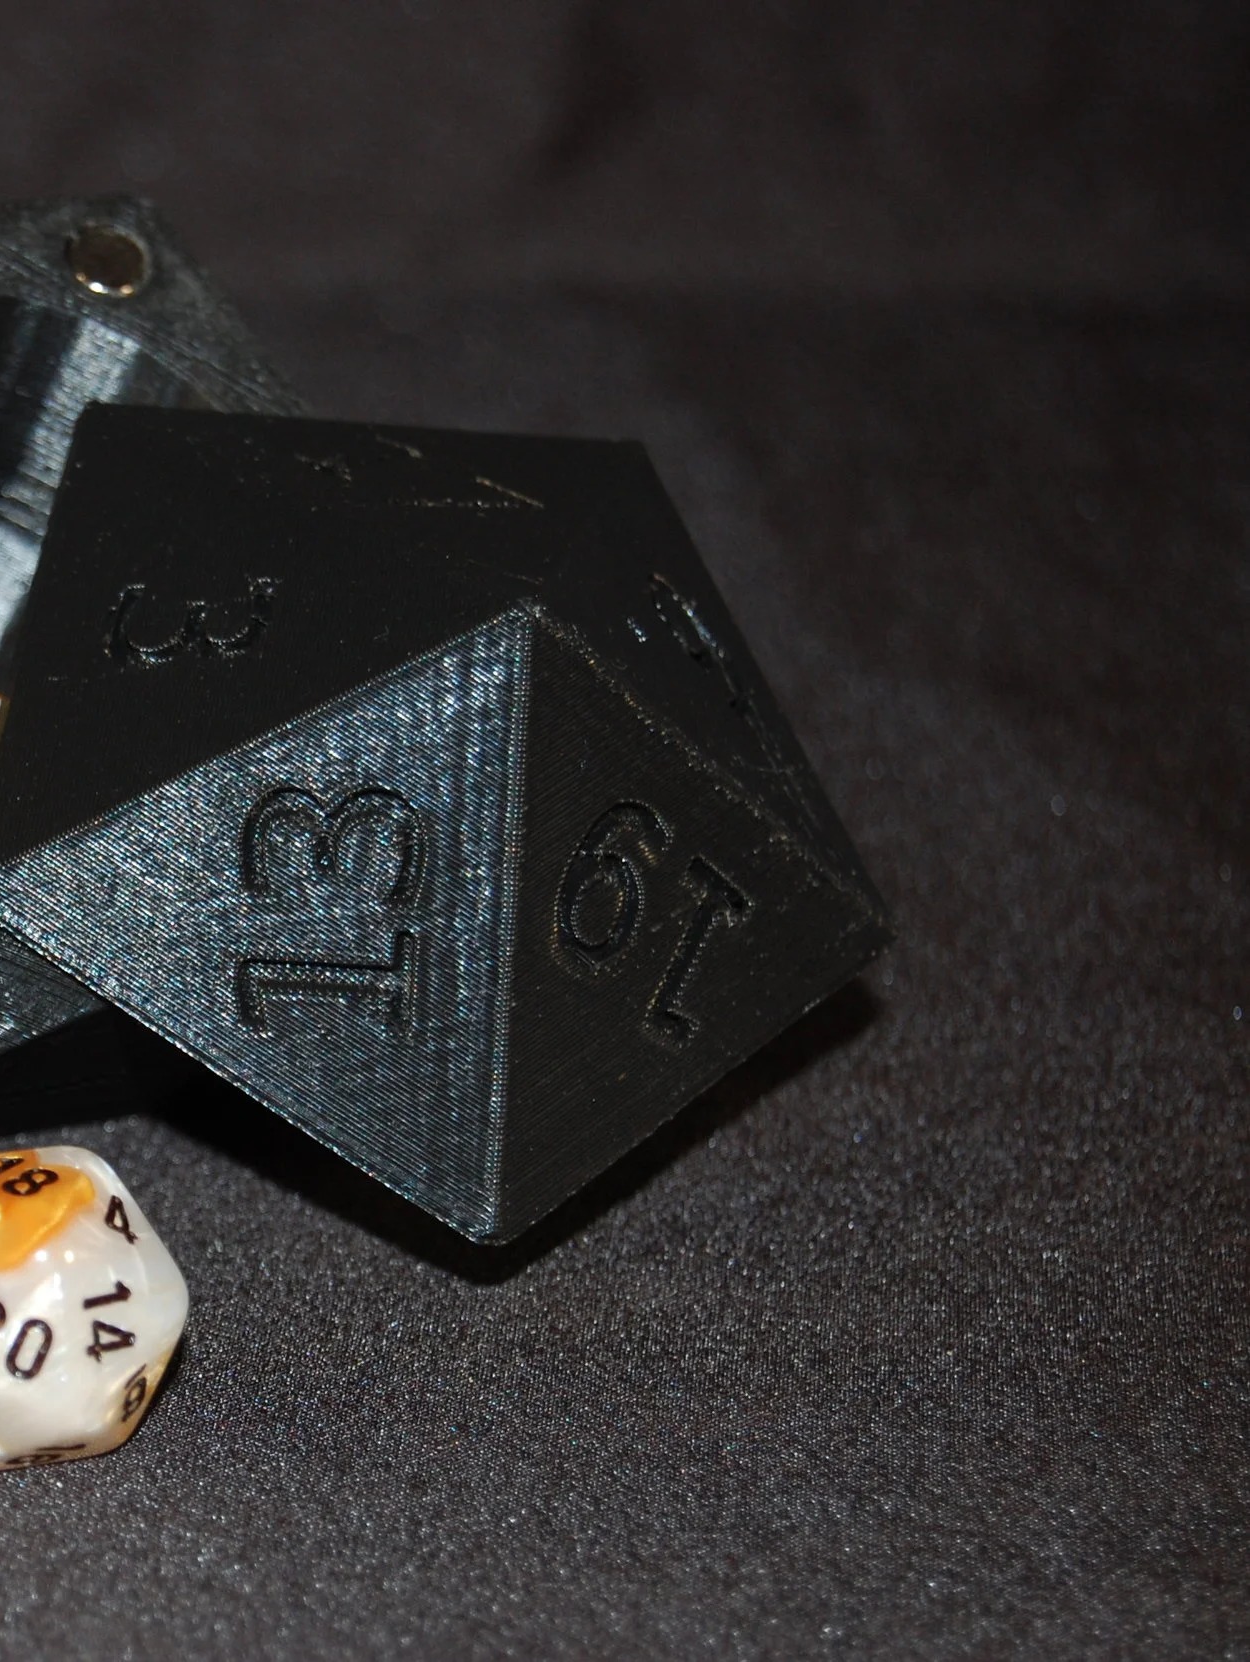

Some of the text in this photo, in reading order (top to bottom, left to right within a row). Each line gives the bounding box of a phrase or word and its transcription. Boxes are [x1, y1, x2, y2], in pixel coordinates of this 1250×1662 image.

[102, 573, 282, 668] 3
[236, 785, 428, 1045] 13
[103, 1194, 140, 1245] 4
[82, 1279, 137, 1364] 14
